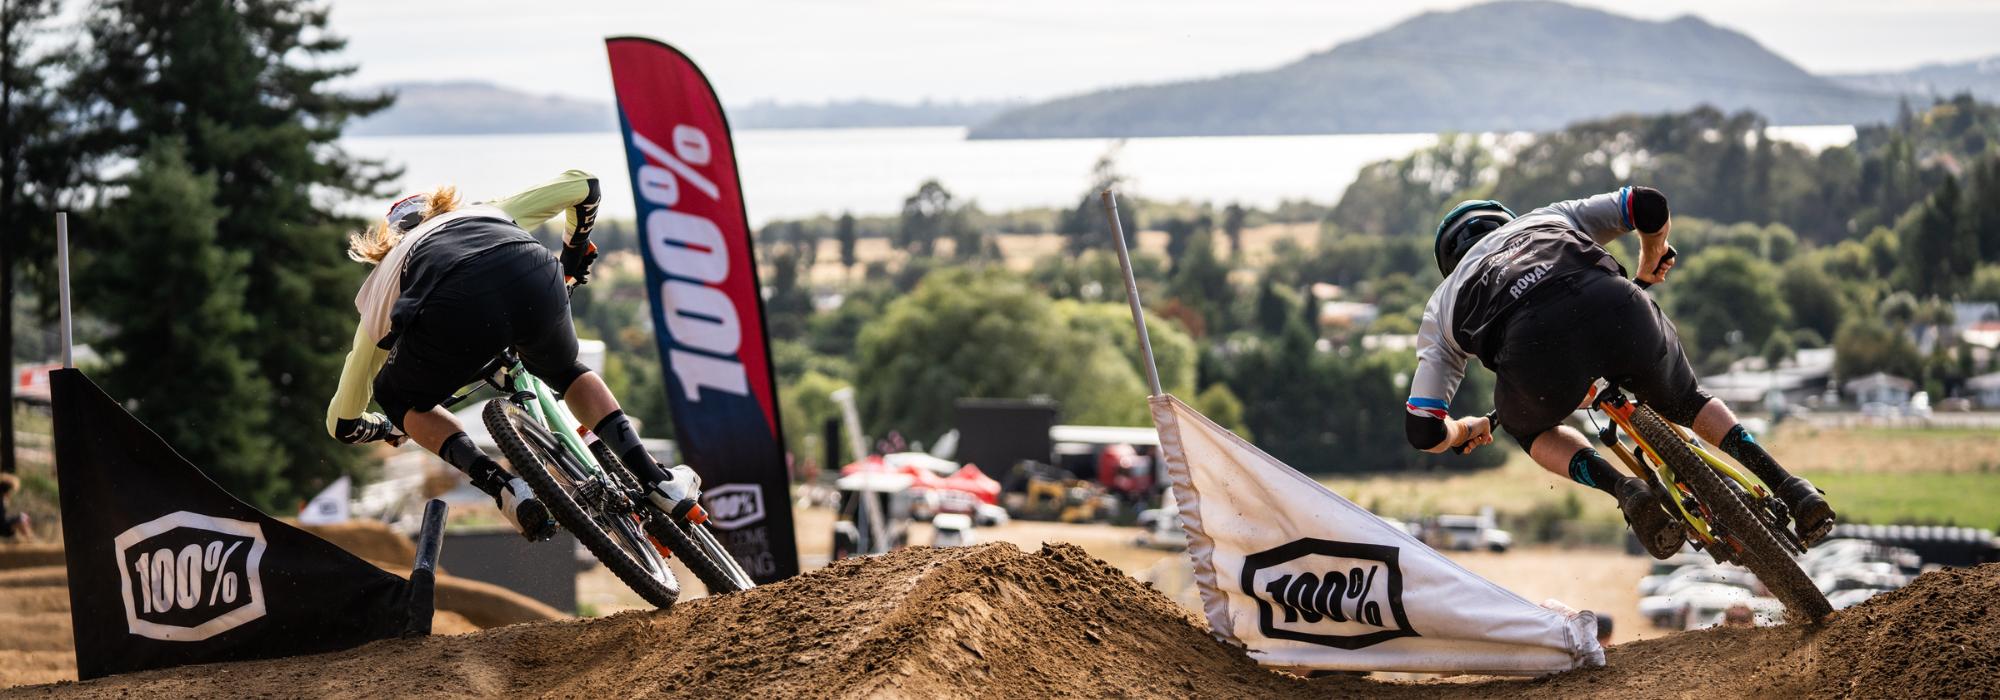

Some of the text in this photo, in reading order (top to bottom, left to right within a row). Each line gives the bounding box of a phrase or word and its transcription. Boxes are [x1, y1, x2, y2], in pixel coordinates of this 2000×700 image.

[632, 124, 749, 402] 100%
[1509, 262, 1553, 300] ROYAL
[711, 492, 755, 518] 100%
[135, 540, 243, 614] 100%
[1265, 565, 1383, 627] 100%
